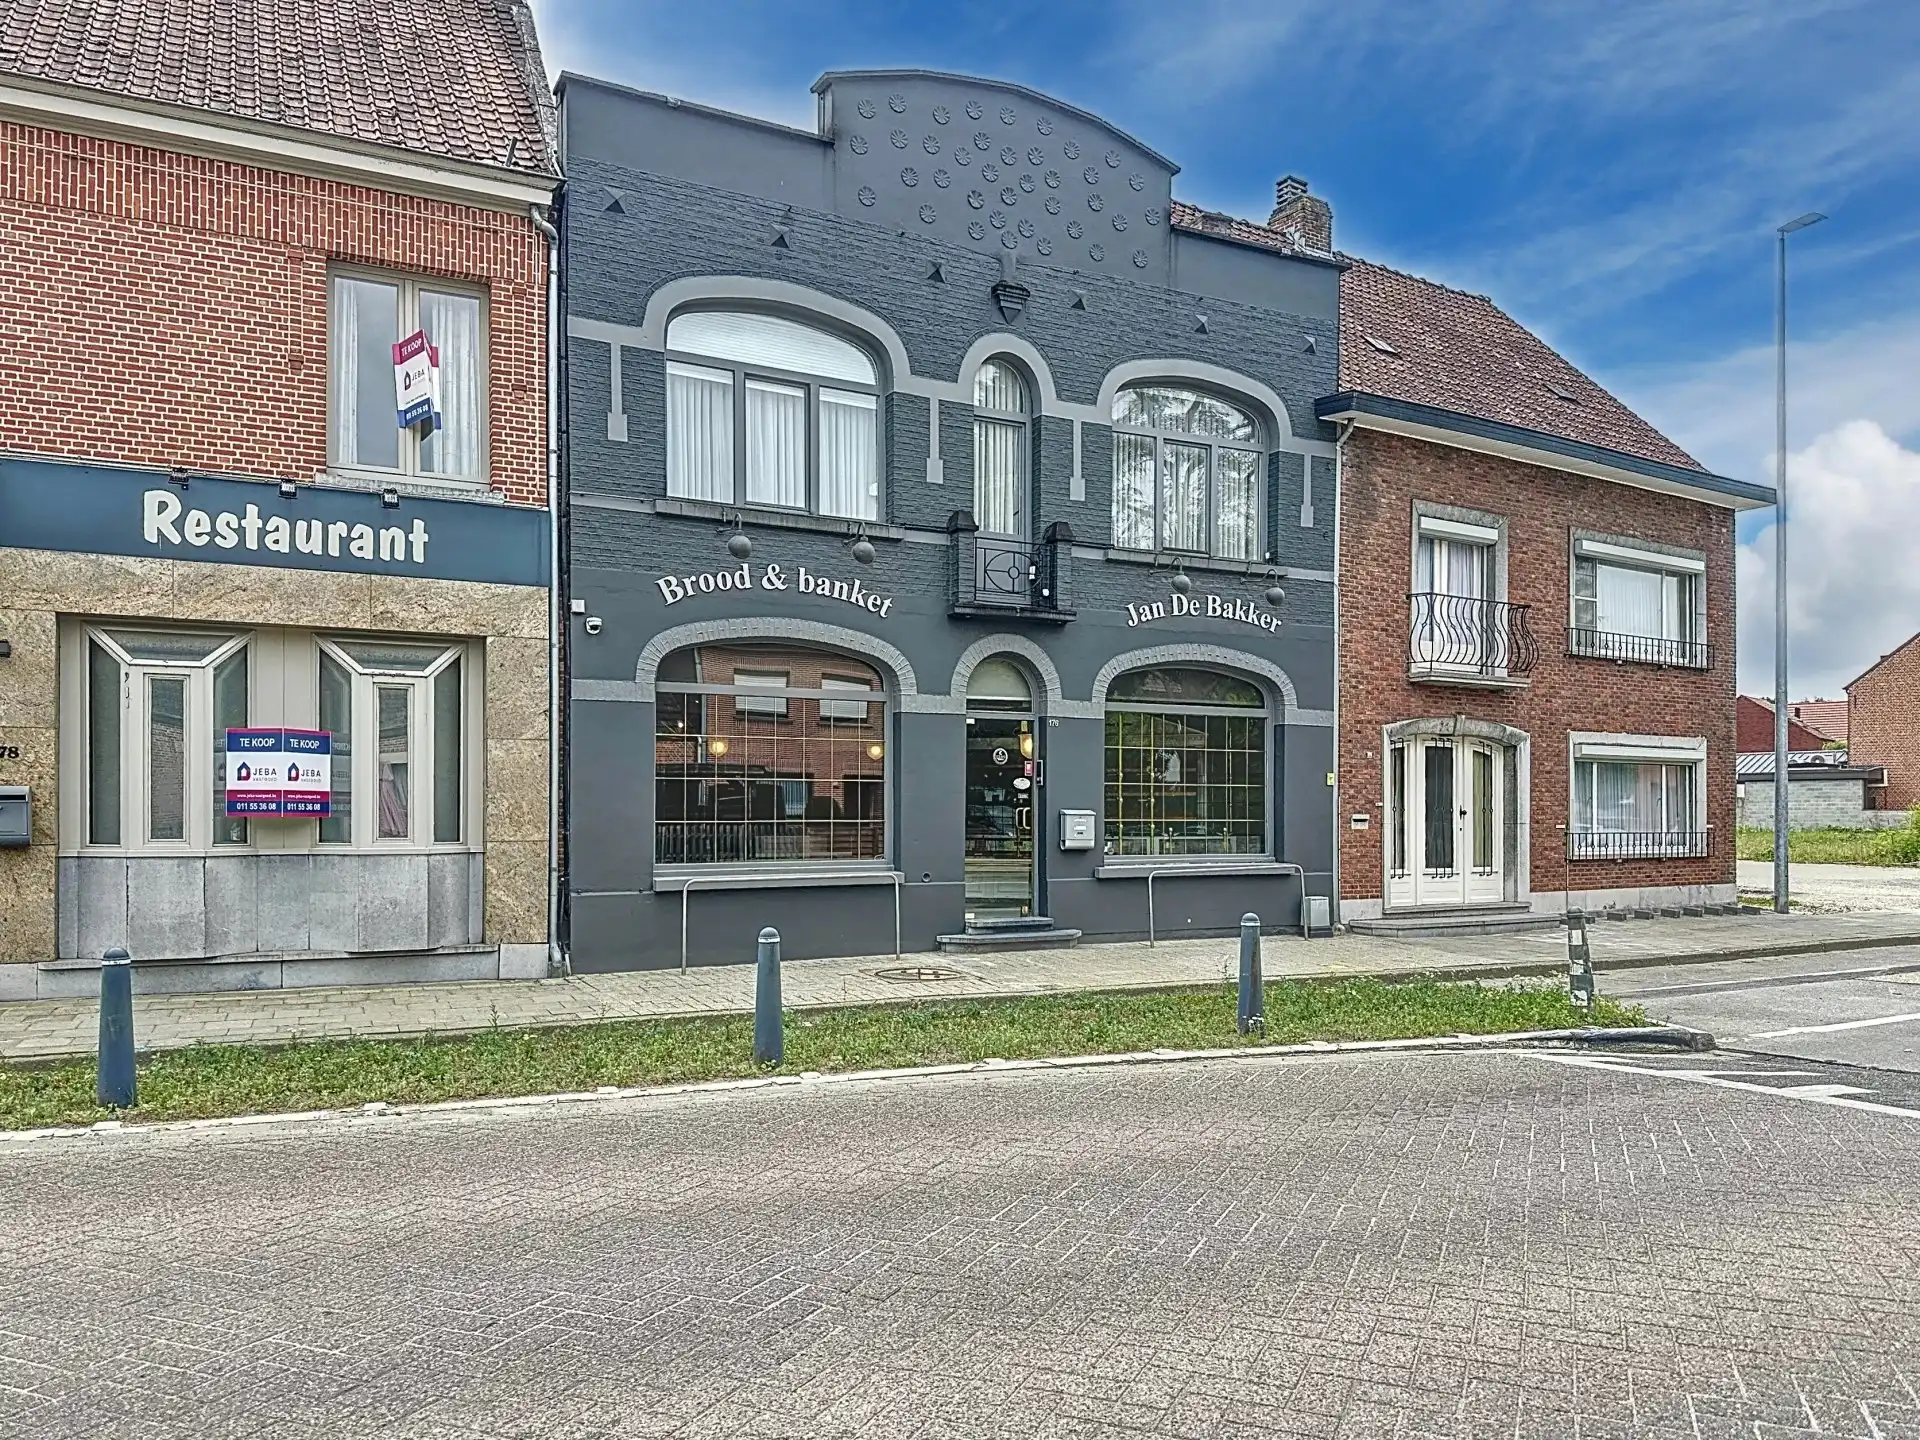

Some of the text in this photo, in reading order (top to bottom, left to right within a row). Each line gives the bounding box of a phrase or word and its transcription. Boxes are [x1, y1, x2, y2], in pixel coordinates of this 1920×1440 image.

[401, 338, 422, 357] TE KOOP
[411, 370, 425, 381] JEBA
[143, 489, 429, 564] Restaurant
[654, 563, 893, 618] Brood & banket
[1125, 593, 1282, 634] Jan De Bakker
[239, 738, 275, 747] TE KOOP
[289, 739, 320, 749] TE KOOP
[252, 767, 277, 776] JEBA
[300, 769, 321, 777] JEBA
[287, 803, 297, 811] 011
[297, 803, 305, 811] 55
